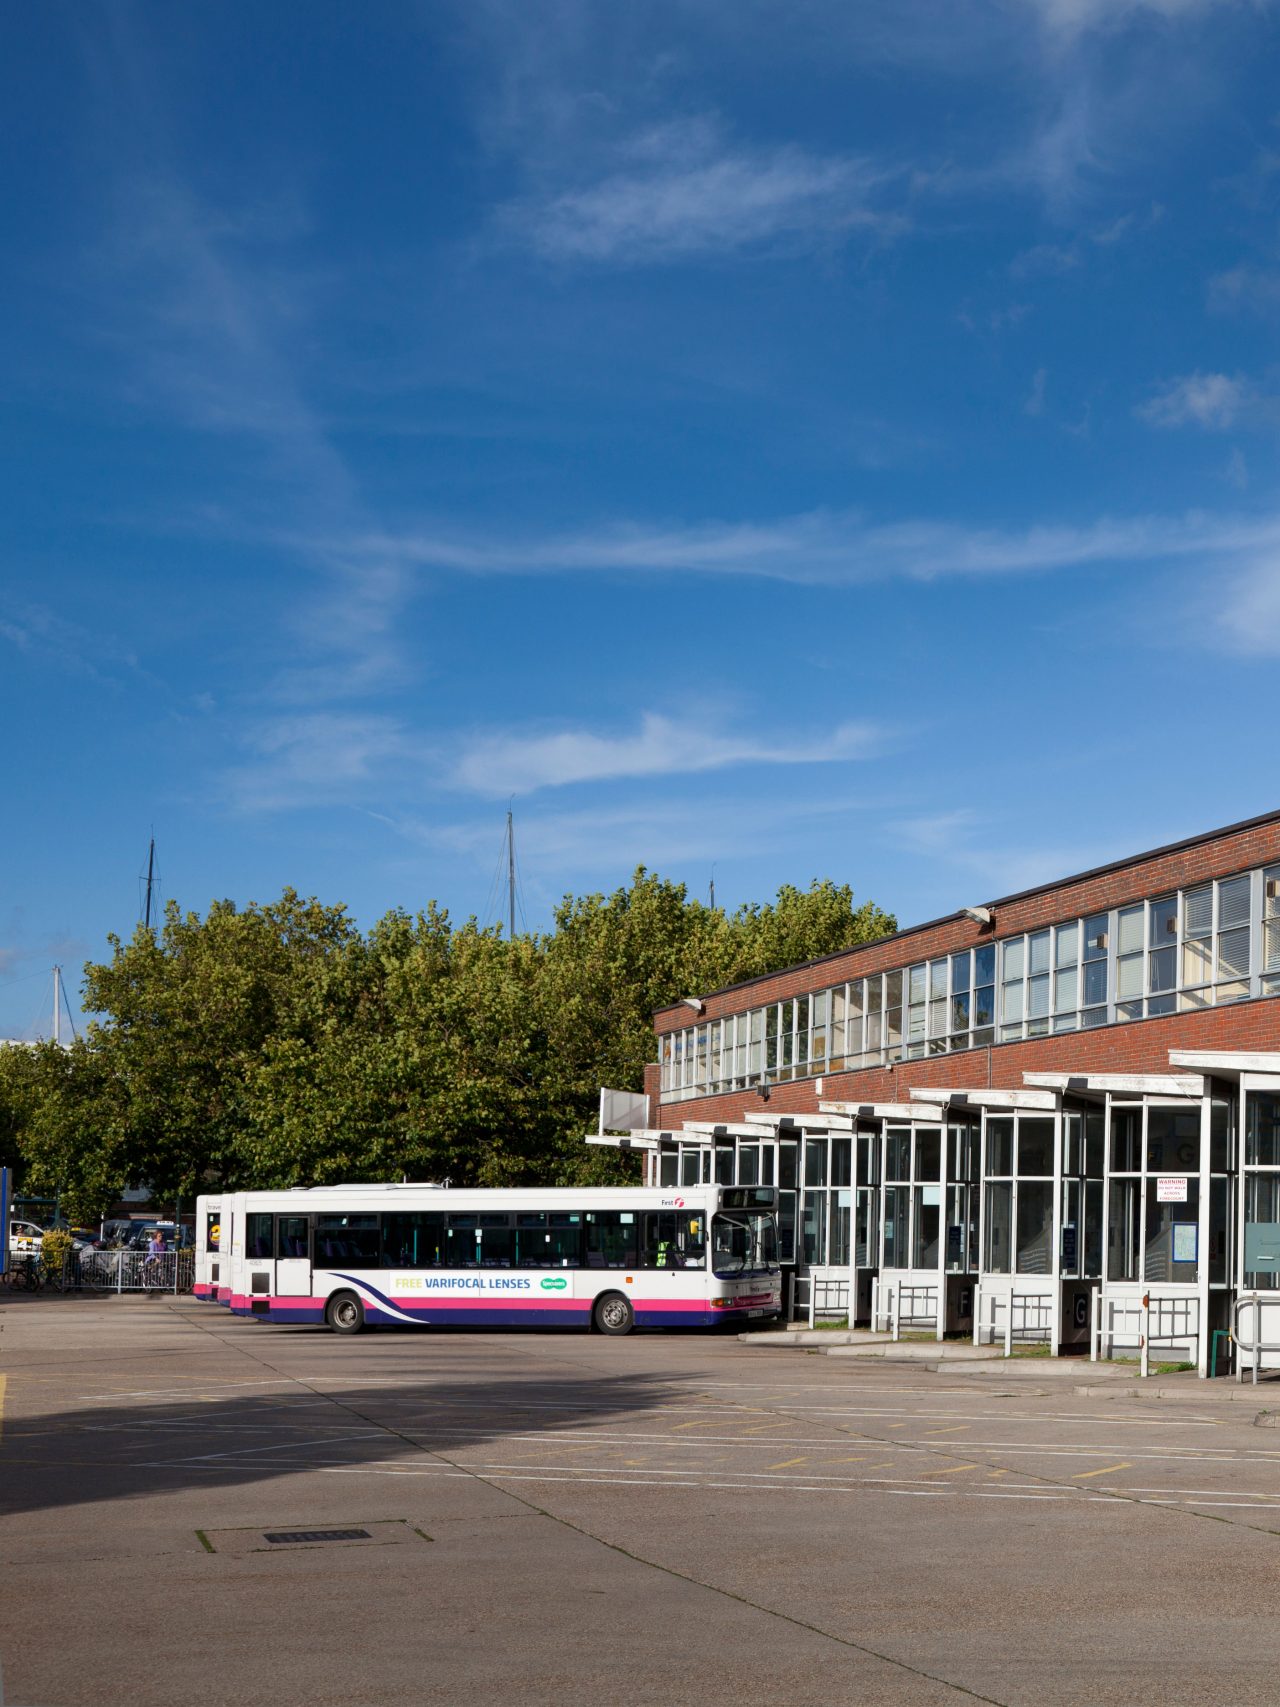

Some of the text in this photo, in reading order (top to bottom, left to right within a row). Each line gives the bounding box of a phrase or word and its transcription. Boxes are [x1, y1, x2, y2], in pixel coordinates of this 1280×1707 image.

[395, 1278, 531, 1289] FREE VARIFOCAL LENSES
[960, 1290, 969, 1314] F
[1075, 1297, 1087, 1324] G
